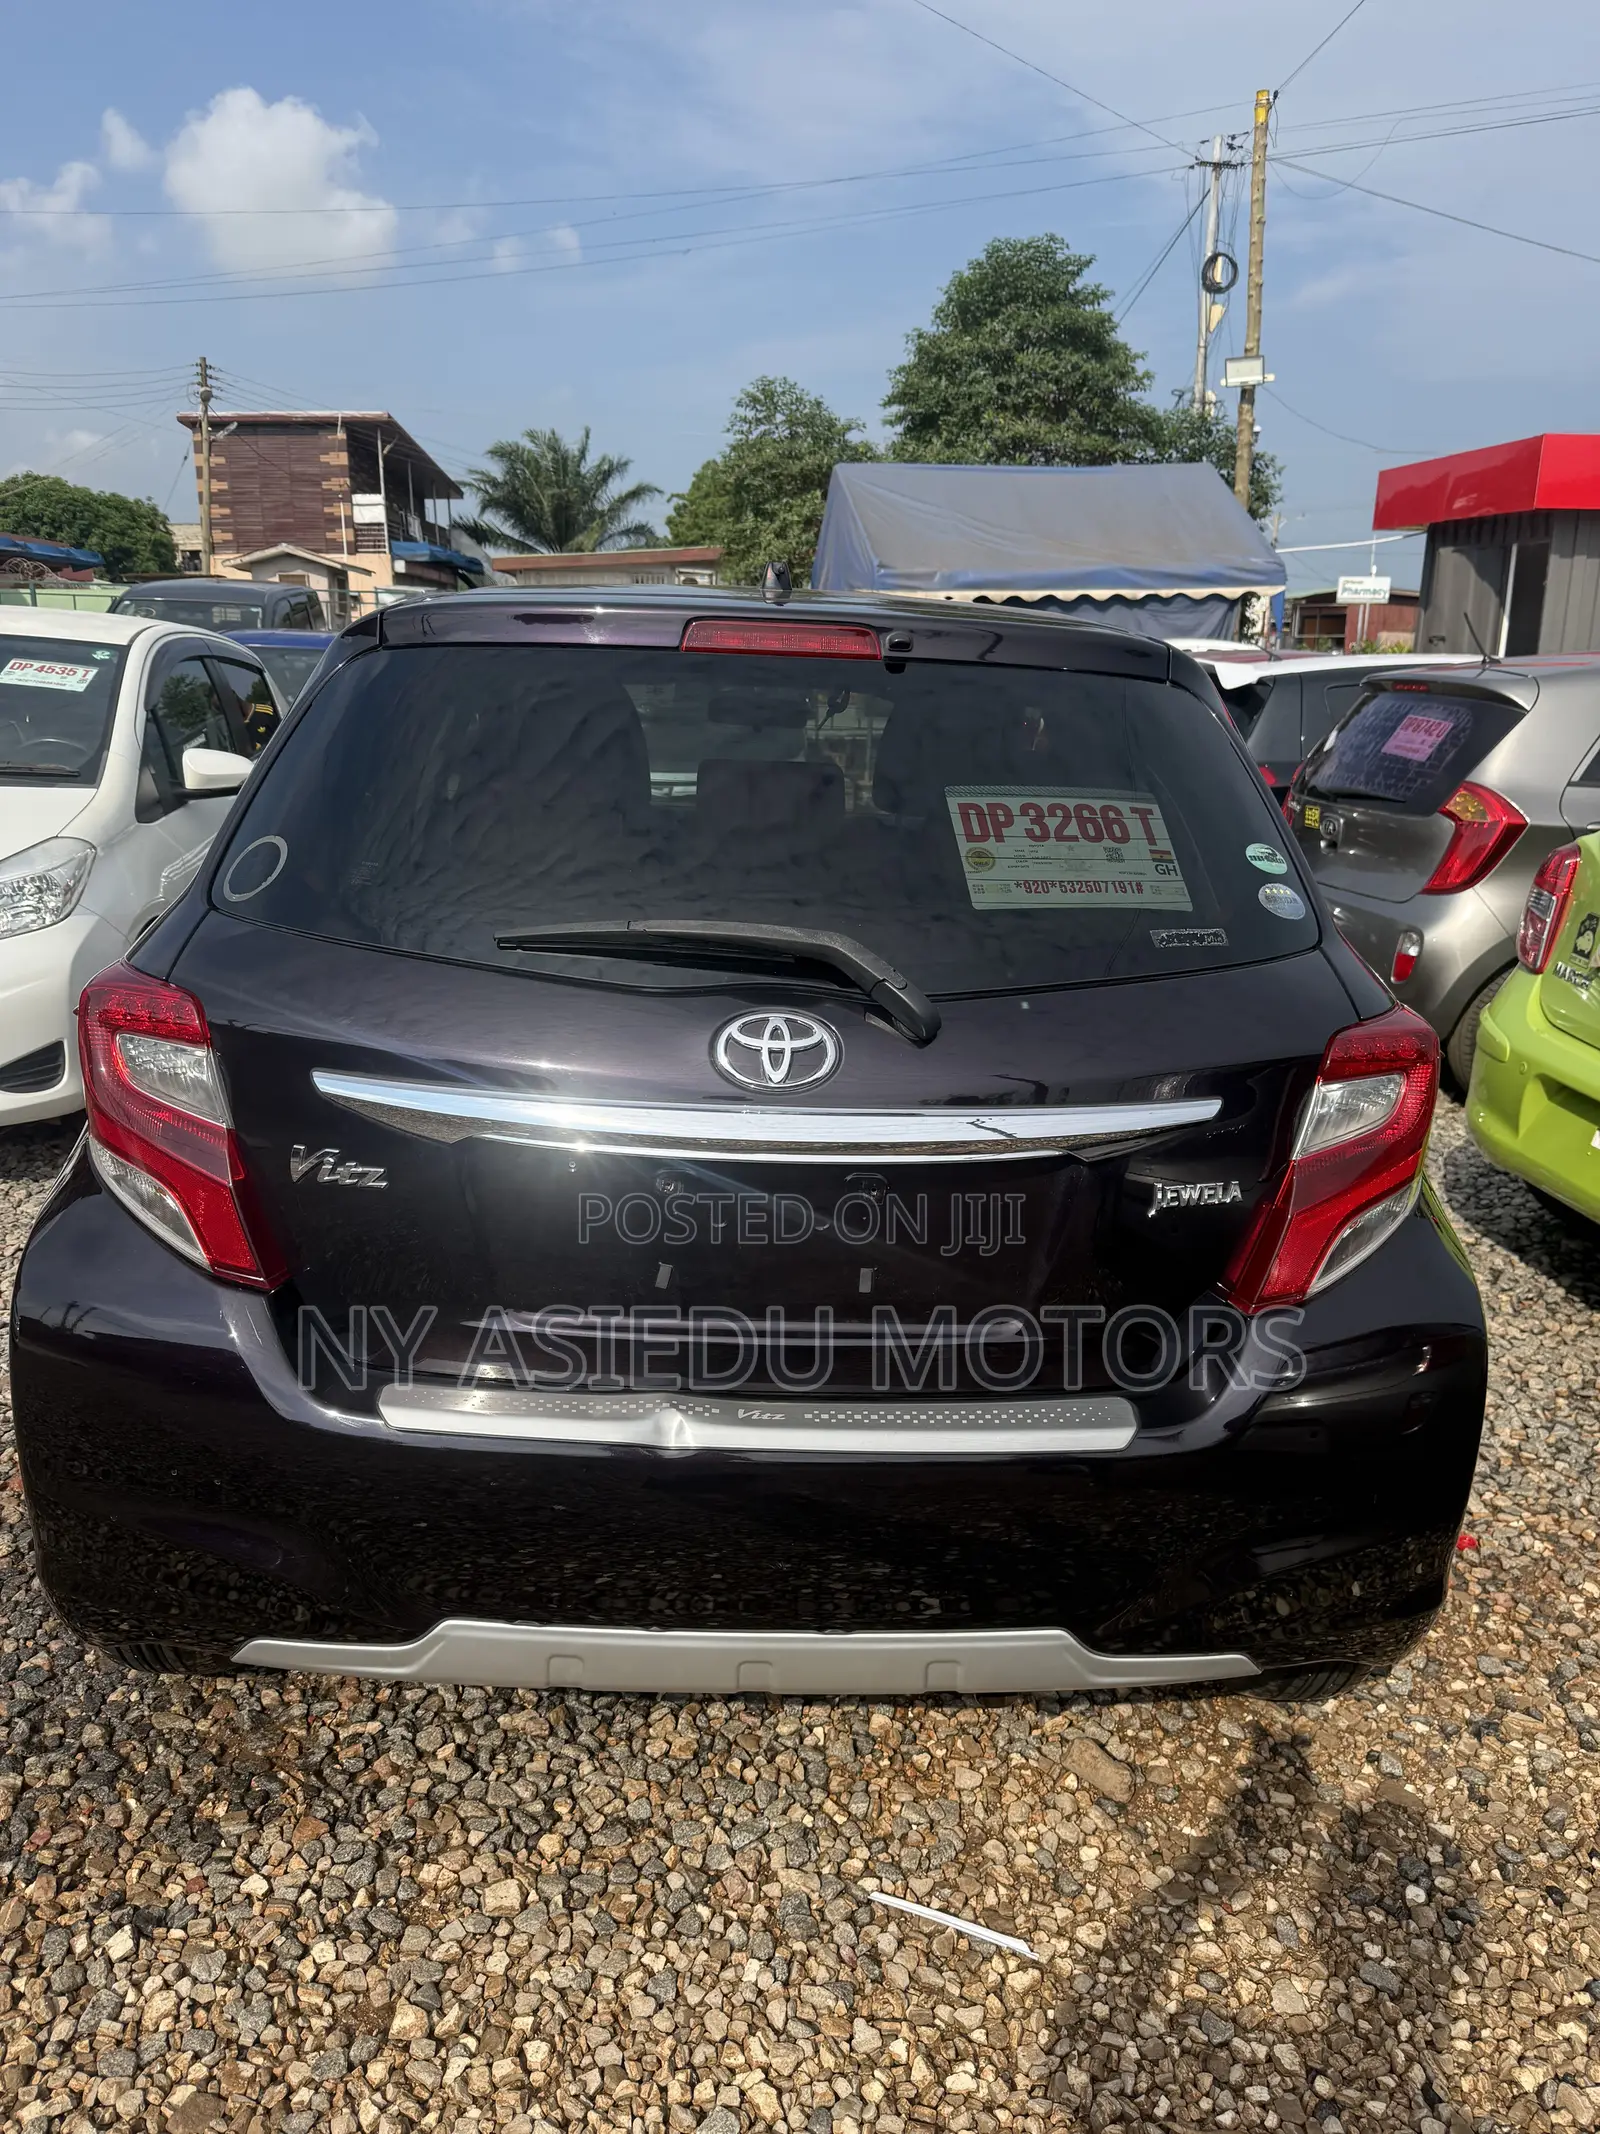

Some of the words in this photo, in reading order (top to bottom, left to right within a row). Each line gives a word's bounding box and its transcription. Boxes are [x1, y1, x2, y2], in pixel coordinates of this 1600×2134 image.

[9, 661, 34, 671] DP
[33, 664, 78, 676] 4535
[81, 669, 93, 678] T
[957, 802, 1015, 843] DP
[1019, 802, 1131, 844] 3266
[1130, 807, 1157, 847] T
[1154, 863, 1178, 876] GH
[290, 1144, 389, 1190] Vitz
[1147, 1180, 1243, 1218] JEWELA
[738, 1408, 785, 1420] Vitz
